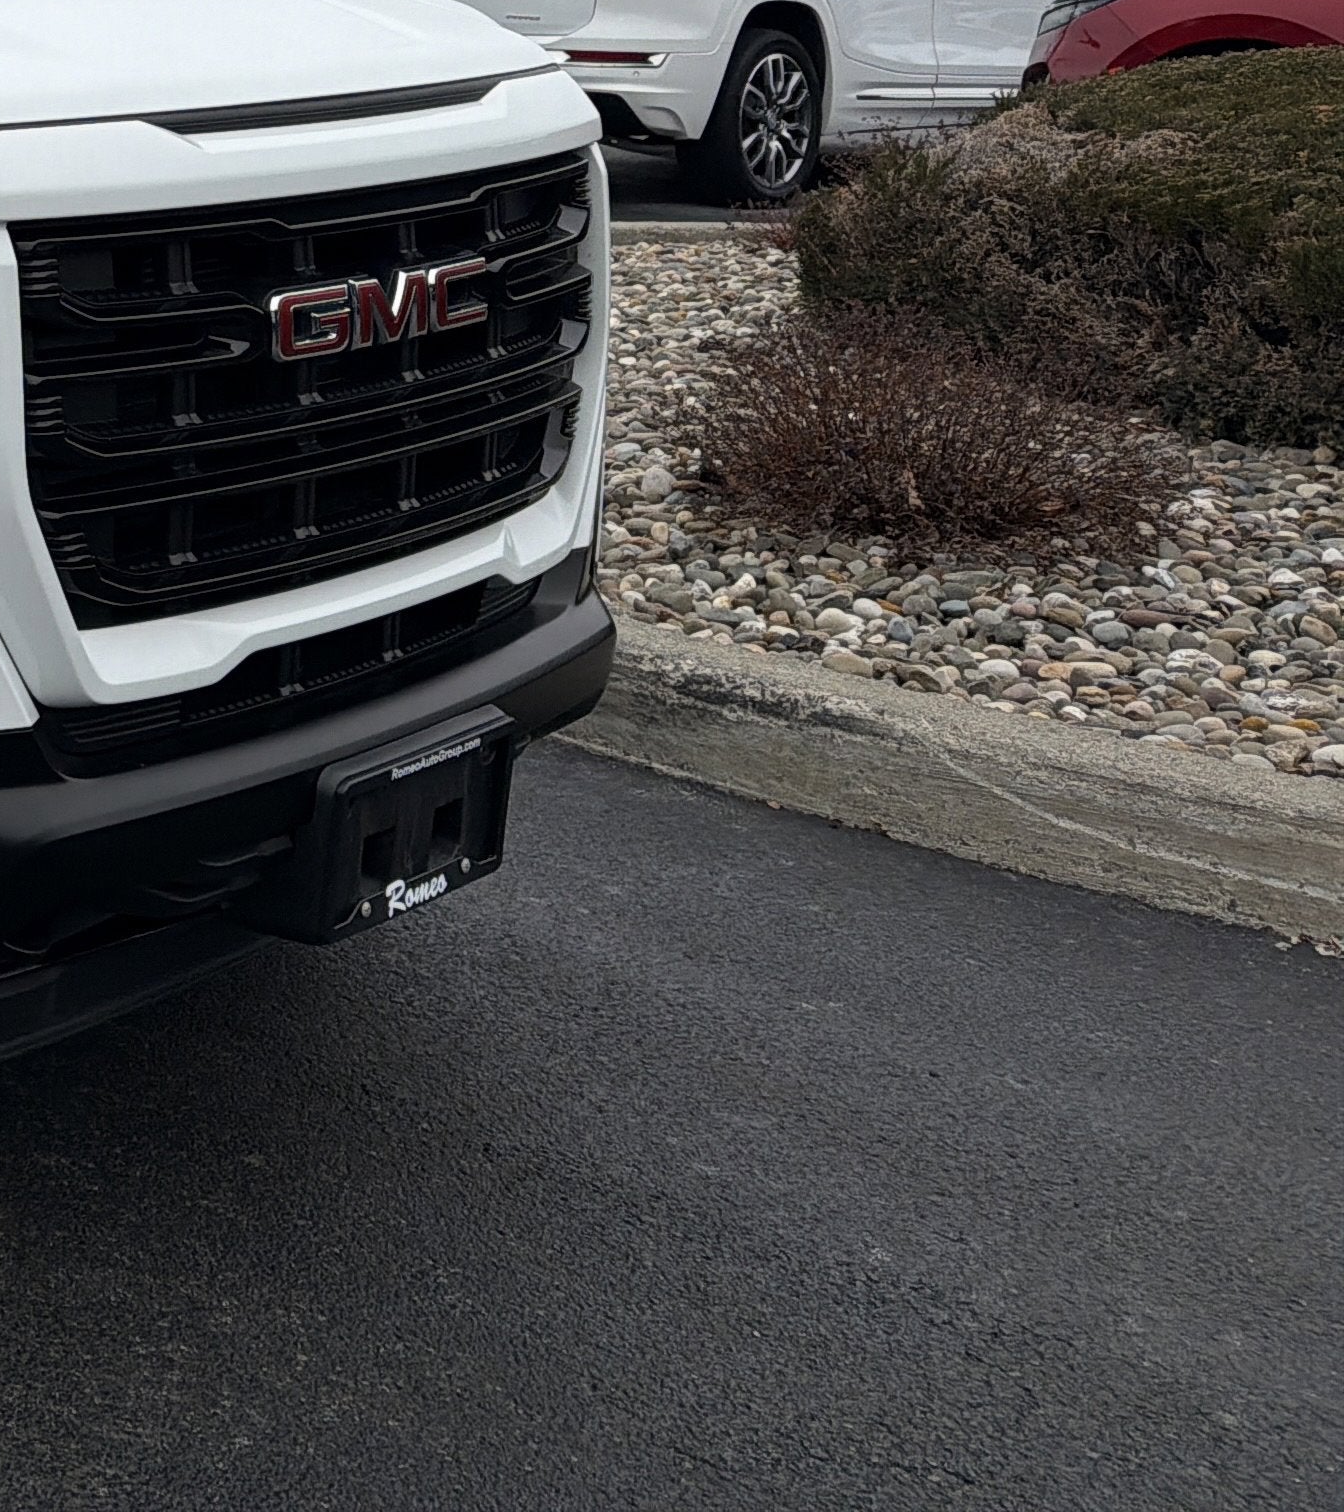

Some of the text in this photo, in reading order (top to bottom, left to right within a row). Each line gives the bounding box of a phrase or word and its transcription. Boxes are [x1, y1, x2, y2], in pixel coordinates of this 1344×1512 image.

[269, 256, 489, 361] GMC
[391, 737, 481, 781] RomeoAutoGroup.com
[385, 873, 448, 919] Romeo
